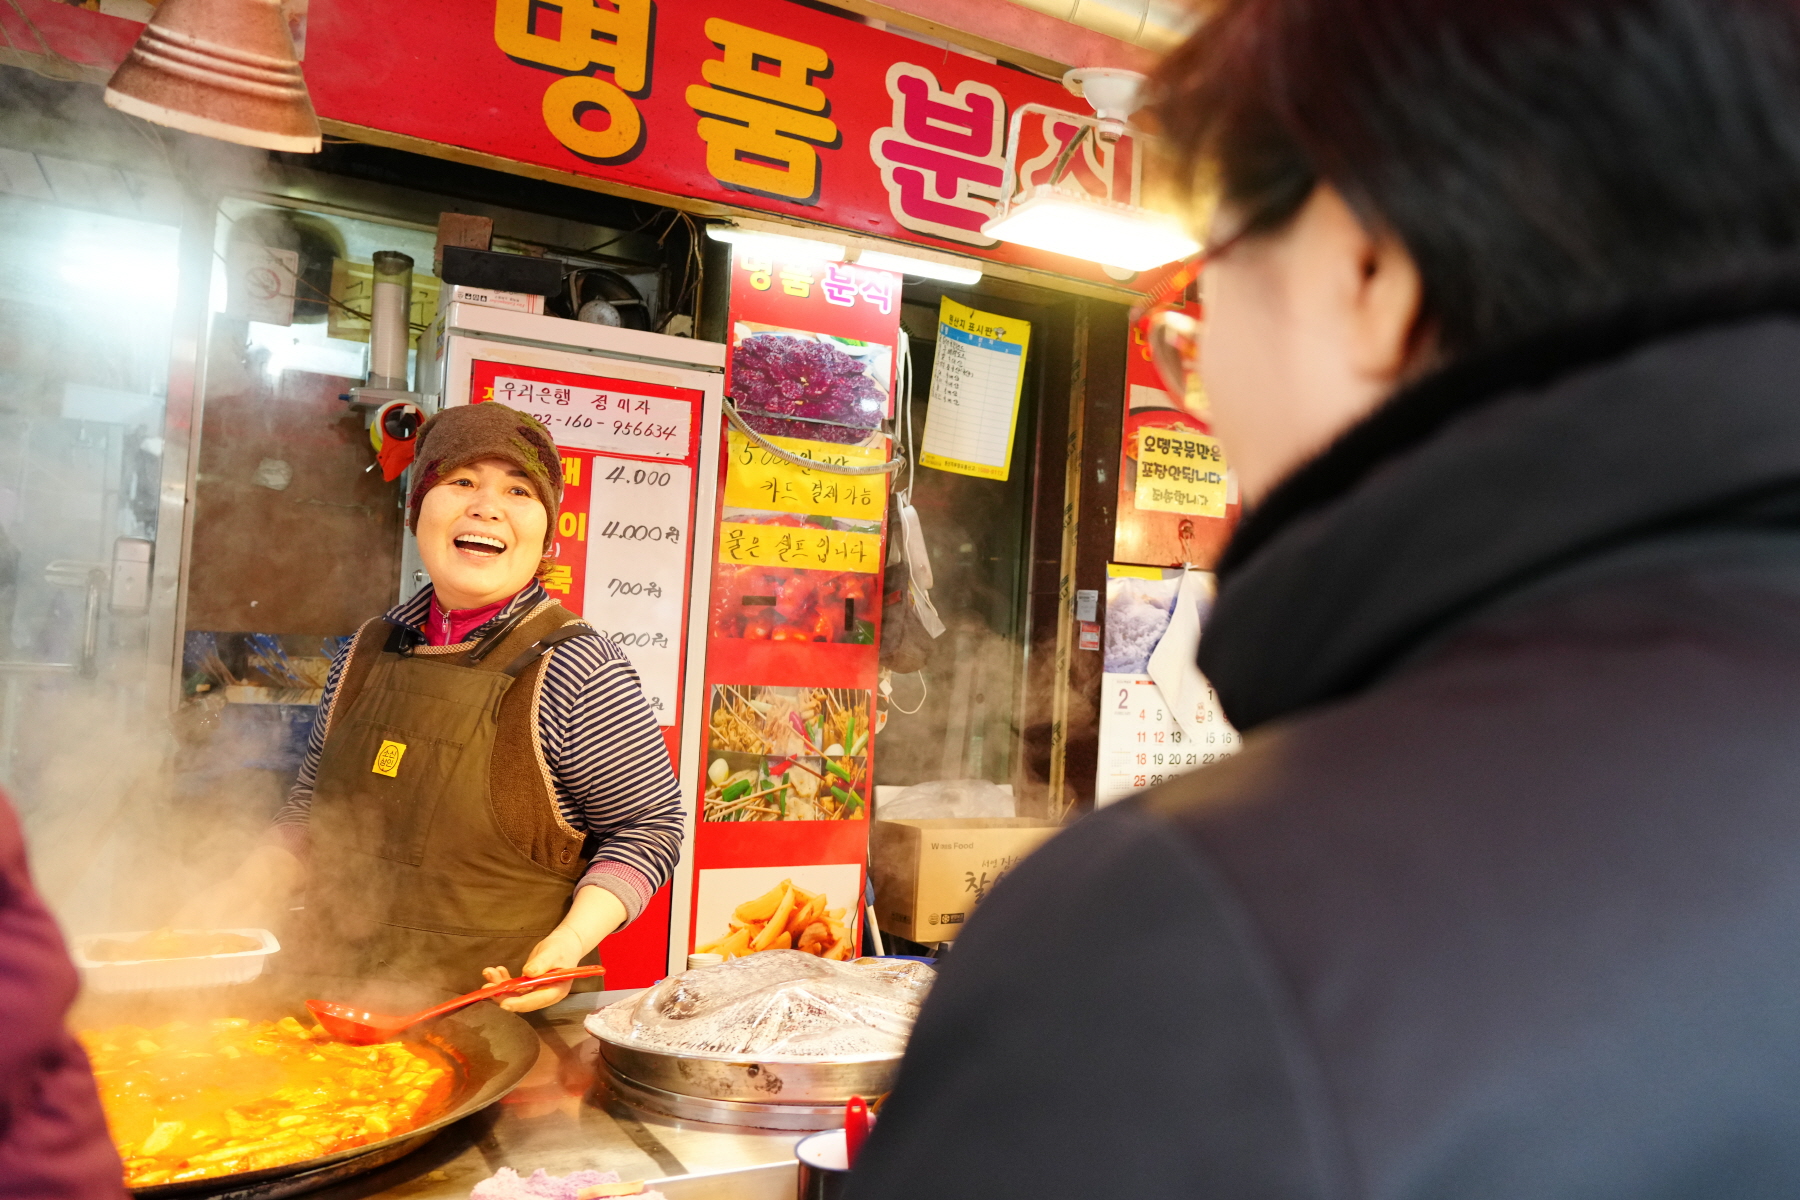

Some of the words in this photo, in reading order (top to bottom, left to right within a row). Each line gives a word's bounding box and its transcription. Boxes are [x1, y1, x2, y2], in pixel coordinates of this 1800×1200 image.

[821, 262, 893, 314] 분식
[949, 314, 966, 330] 원산지
[968, 322, 993, 337] 표시판
[500, 382, 571, 406] 우리은행
[605, 466, 671, 487] 4.000
[760, 477, 798, 503] 카드
[811, 480, 838, 504] 결제
[844, 486, 871, 505] 가능
[602, 521, 680, 544] 4.000원
[725, 529, 759, 560] 물은
[608, 578, 662, 598] 700원
[1118, 688, 1128, 709] 2
[1139, 709, 1146, 720] 4
[1156, 709, 1163, 721] 5
[1137, 731, 1146, 743] 11
[1153, 731, 1165, 743] 12
[1170, 731, 1182, 743] 13
[1205, 731, 1215, 744] 15
[1221, 732, 1232, 744] 16
[1135, 753, 1147, 765] 18
[1152, 753, 1164, 765] 19
[1169, 753, 1181, 765] 20
[1186, 753, 1197, 765] 21
[1202, 753, 1215, 765] 22
[1133, 774, 1146, 787] 25
[1150, 774, 1163, 786] 26
[953, 842, 974, 850] Food
